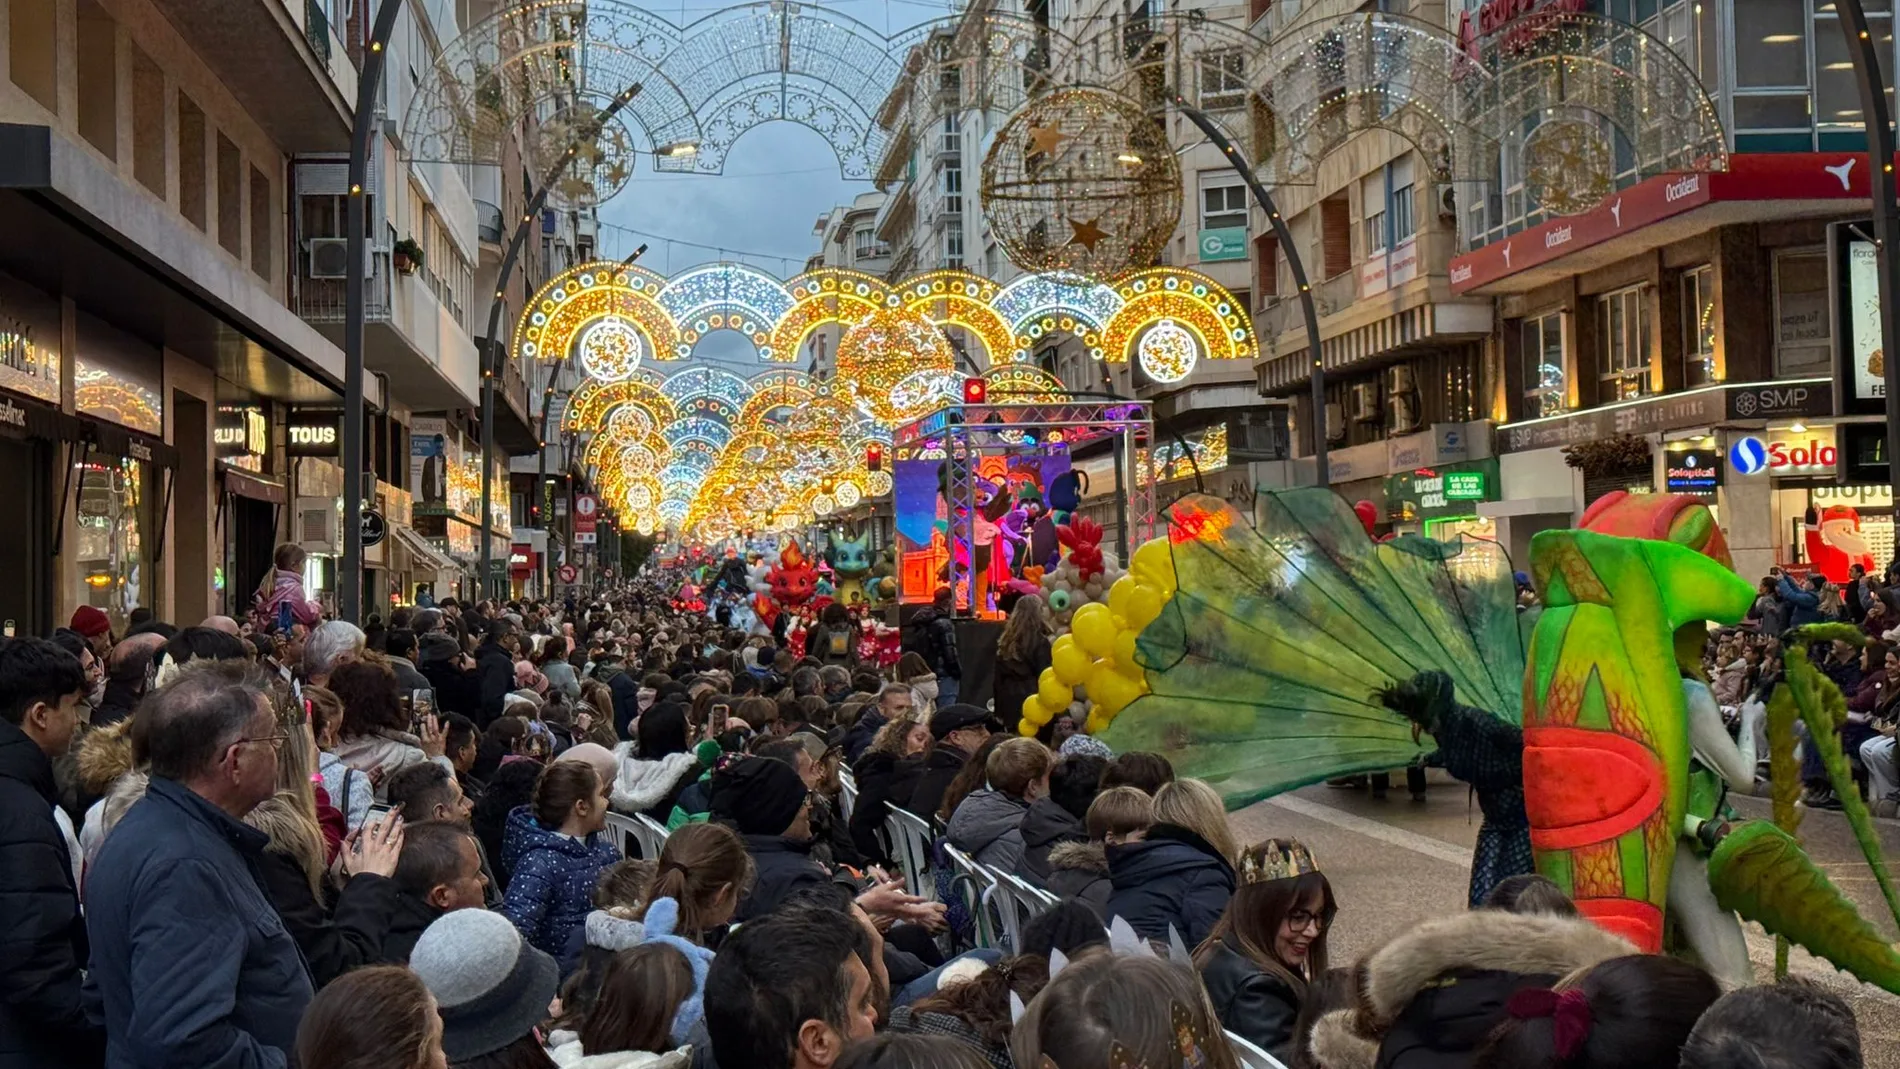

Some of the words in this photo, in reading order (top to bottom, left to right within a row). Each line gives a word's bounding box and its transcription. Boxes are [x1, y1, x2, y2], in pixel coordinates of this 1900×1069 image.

[1665, 173, 1700, 202] Occident
[1545, 224, 1573, 248] Occident
[1451, 264, 1472, 284] Occident
[1760, 388, 1808, 408] SMP
[1669, 400, 1704, 420] LIVING
[248, 410, 266, 455] TOUS
[289, 427, 335, 443] TOUS
[1668, 467, 1716, 479] Soloptical
